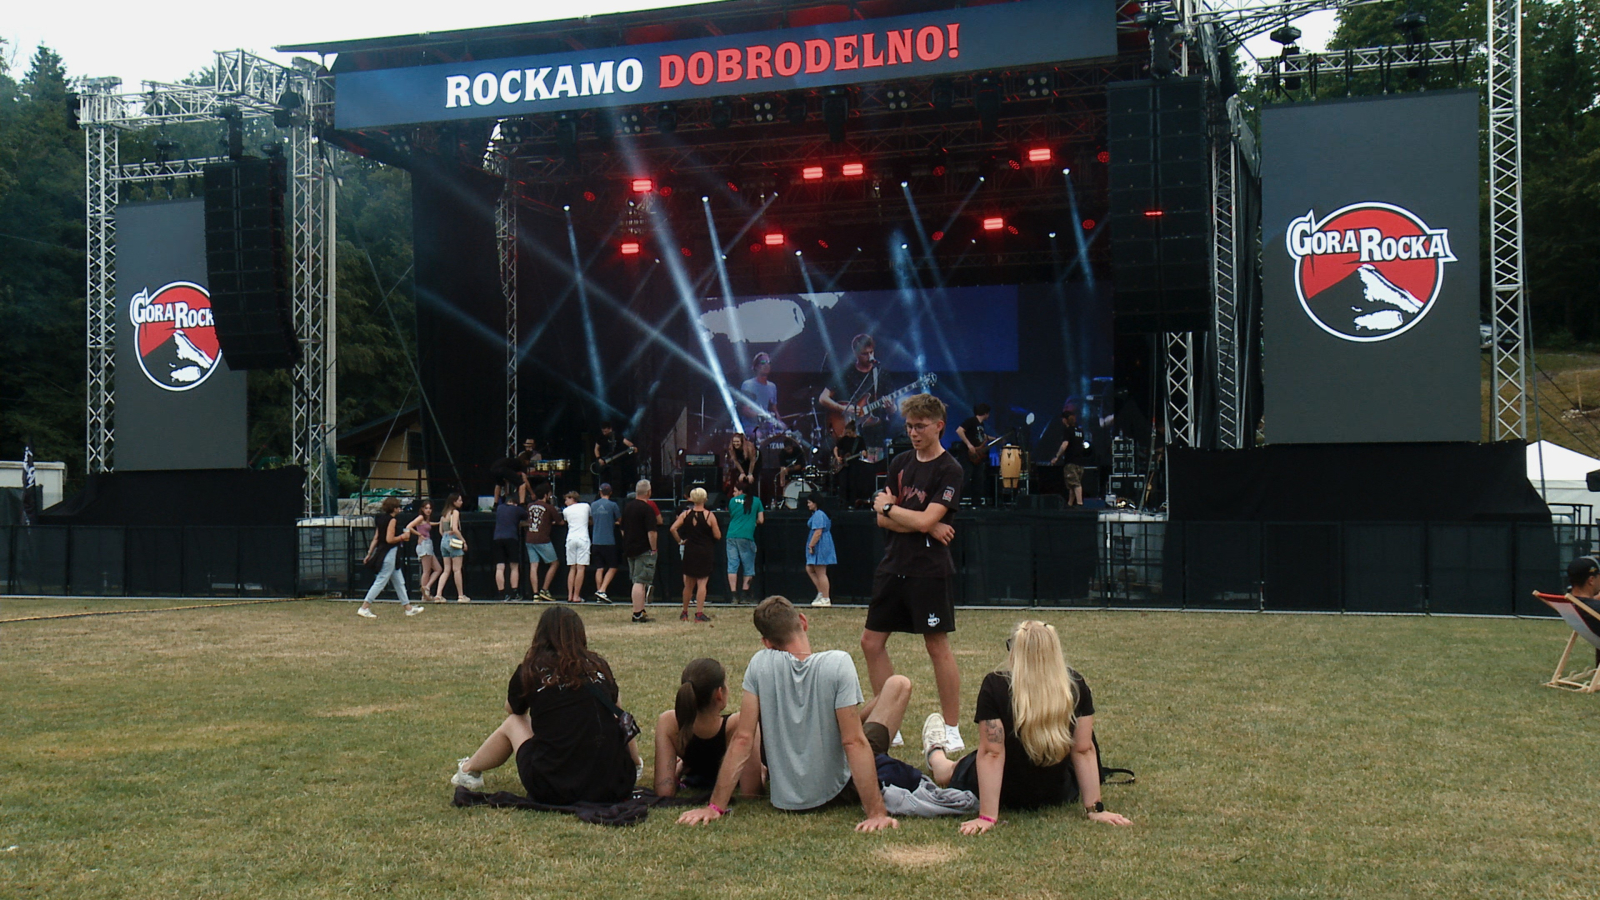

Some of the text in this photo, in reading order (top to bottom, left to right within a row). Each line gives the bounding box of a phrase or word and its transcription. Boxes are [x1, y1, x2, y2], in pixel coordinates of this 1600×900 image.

[445, 23, 960, 108] ROCKAMO DOBRODELNO!
[175, 301, 215, 329] ROCK
